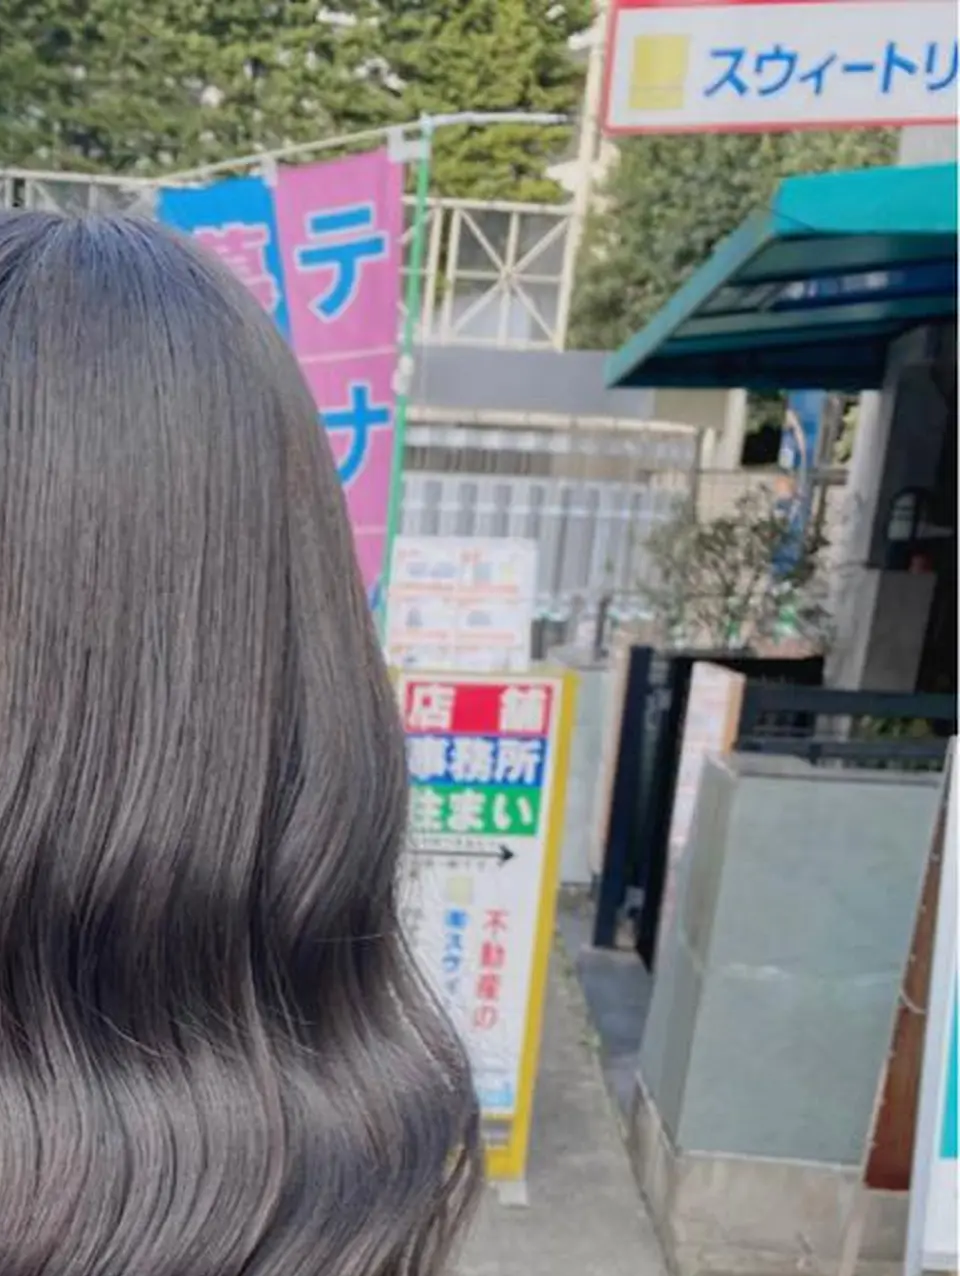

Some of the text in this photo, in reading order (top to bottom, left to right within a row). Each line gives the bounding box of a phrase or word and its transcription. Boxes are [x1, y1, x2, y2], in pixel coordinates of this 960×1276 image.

[702, 39, 957, 99] スウィートリ
[294, 203, 391, 609] テナ
[408, 736, 541, 783] 事務所
[472, 908, 509, 1031] 不動産の
